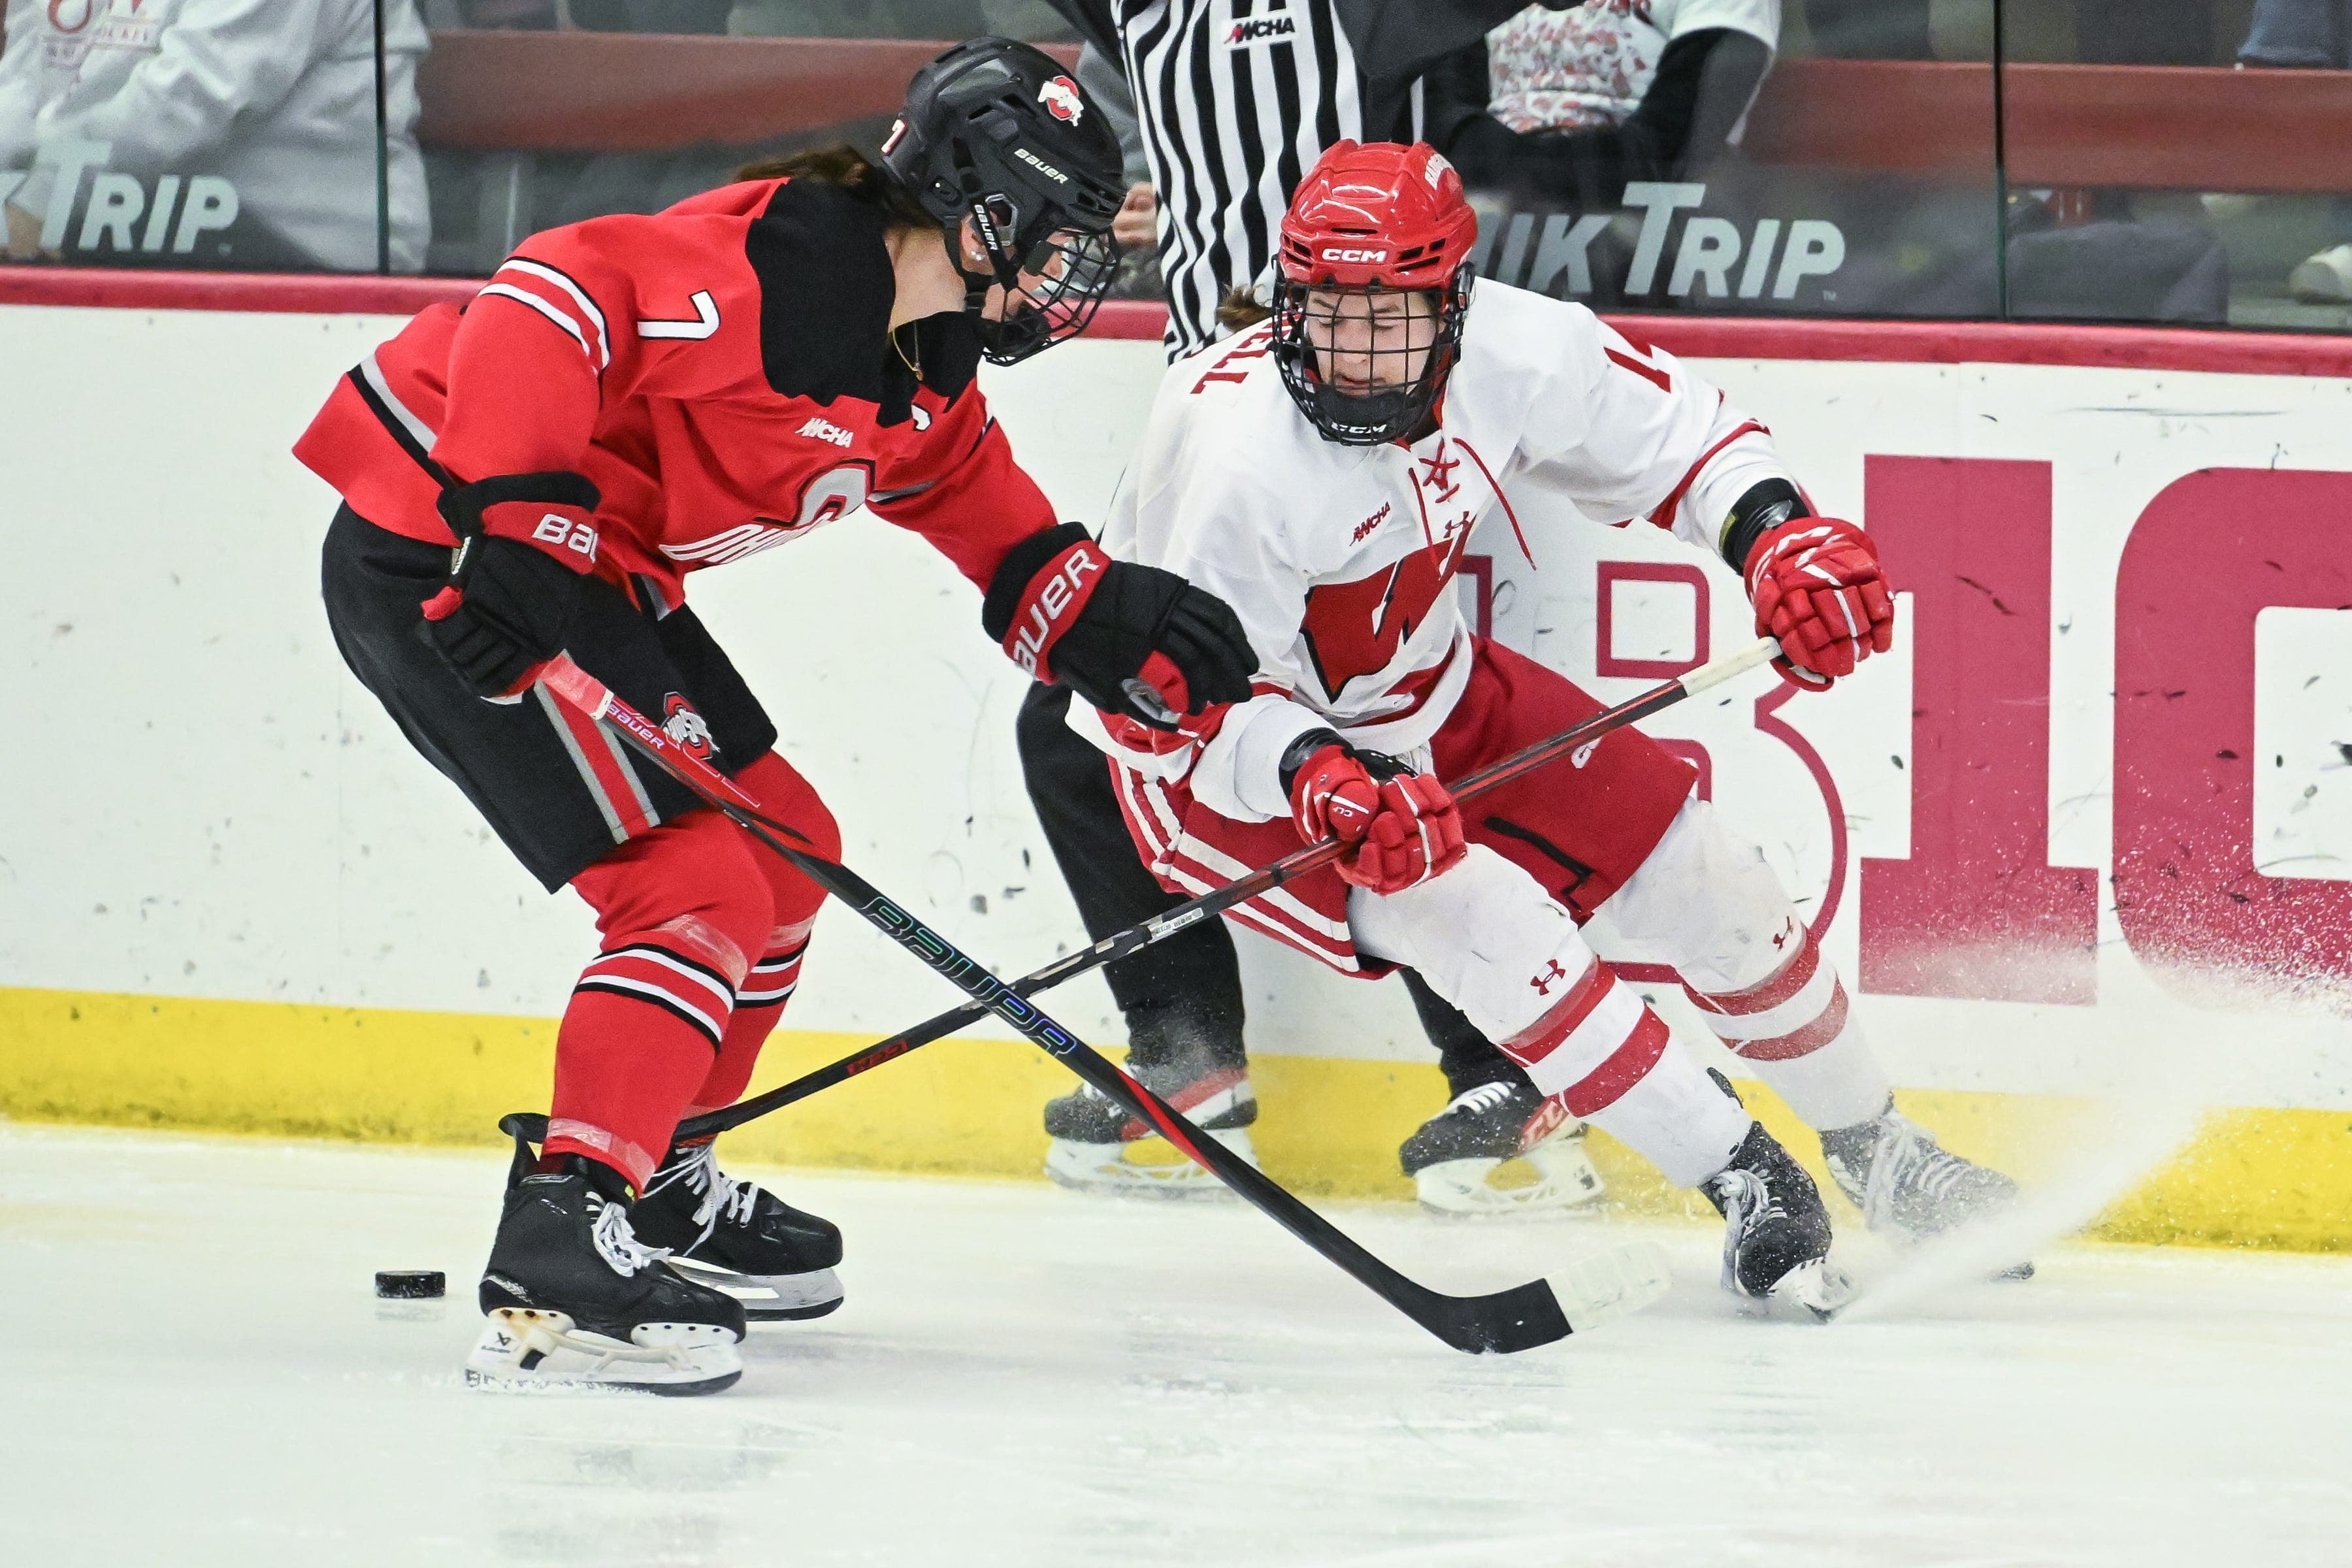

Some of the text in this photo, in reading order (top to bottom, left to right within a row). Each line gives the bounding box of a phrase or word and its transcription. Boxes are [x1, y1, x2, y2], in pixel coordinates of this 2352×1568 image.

[1014, 148, 1069, 184] BAUER
[35, 140, 239, 253] TRIP
[974, 204, 998, 250] BAUER
[1622, 182, 1845, 299] TRIP
[1322, 248, 1387, 263] CCM
[636, 289, 721, 340] 7
